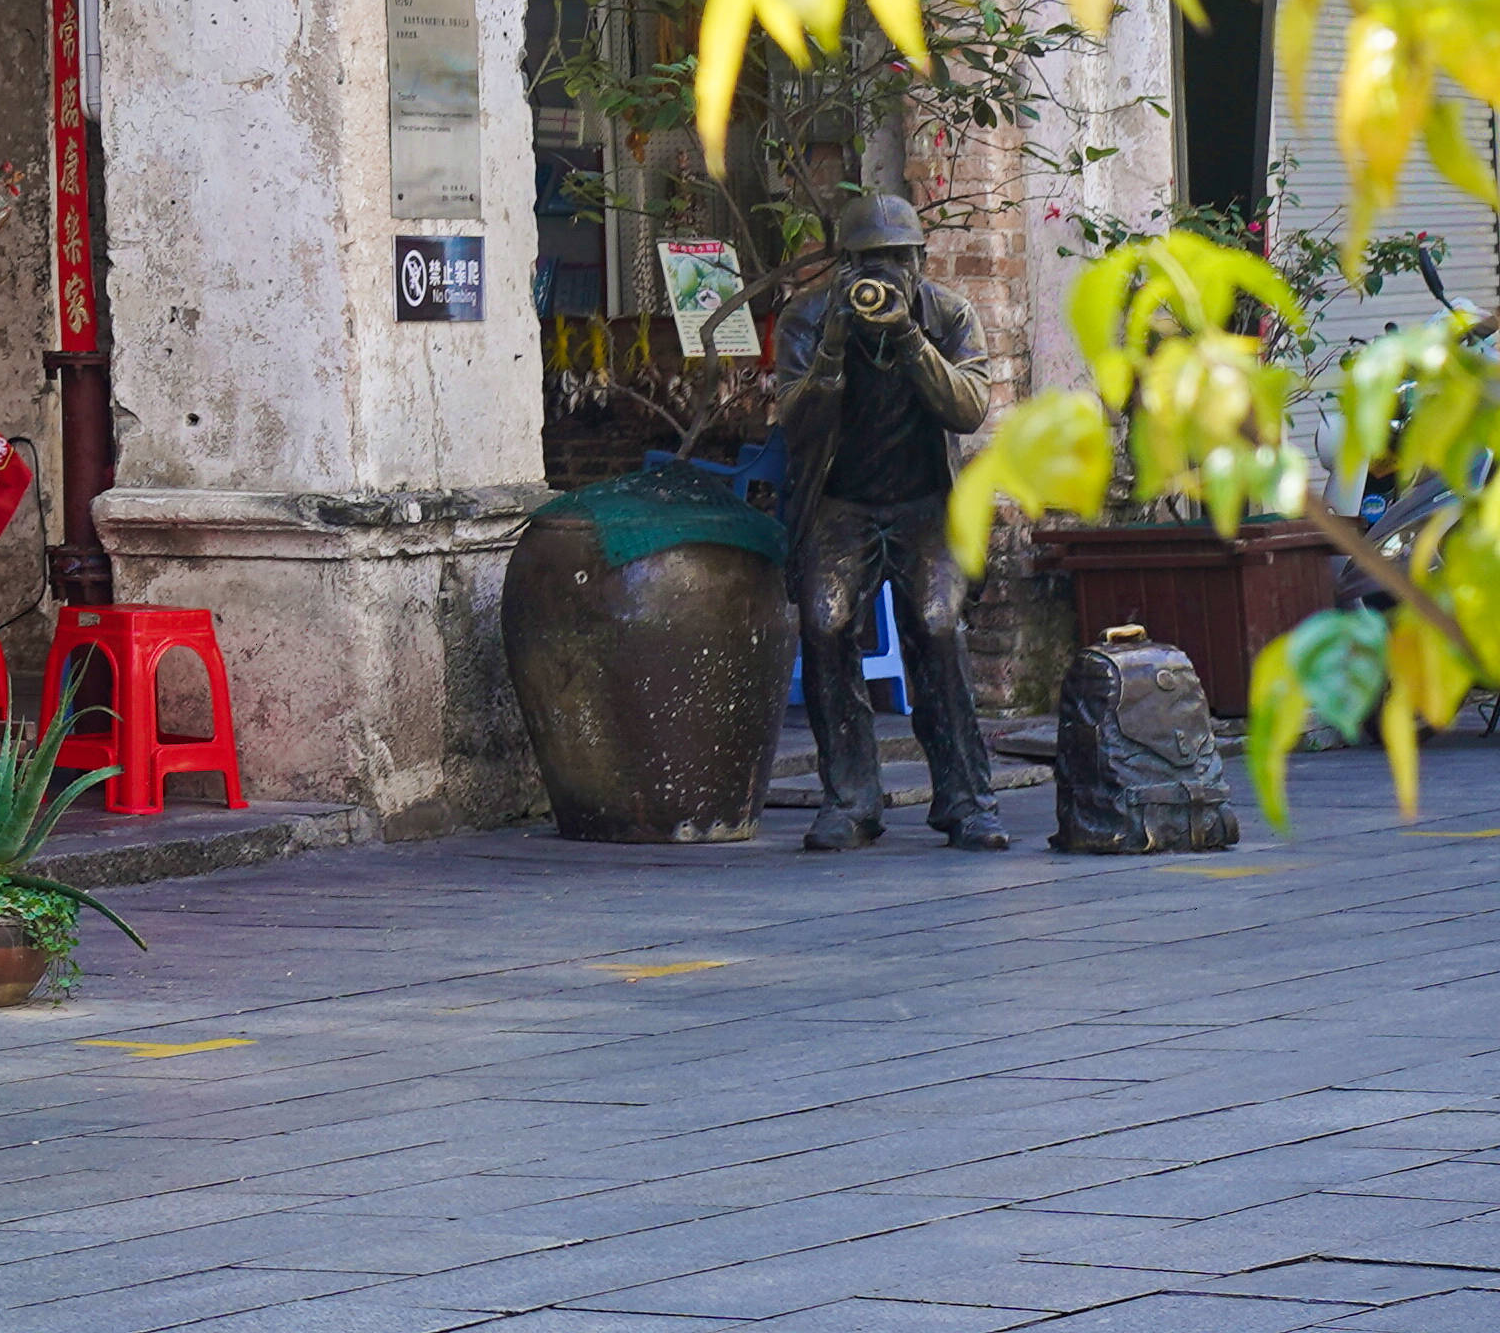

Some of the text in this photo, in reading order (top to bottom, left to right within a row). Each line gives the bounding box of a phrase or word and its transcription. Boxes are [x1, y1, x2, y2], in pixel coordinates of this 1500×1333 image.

[428, 259, 480, 287] 禁止攀爬
[432, 289, 477, 308] No Climbing
